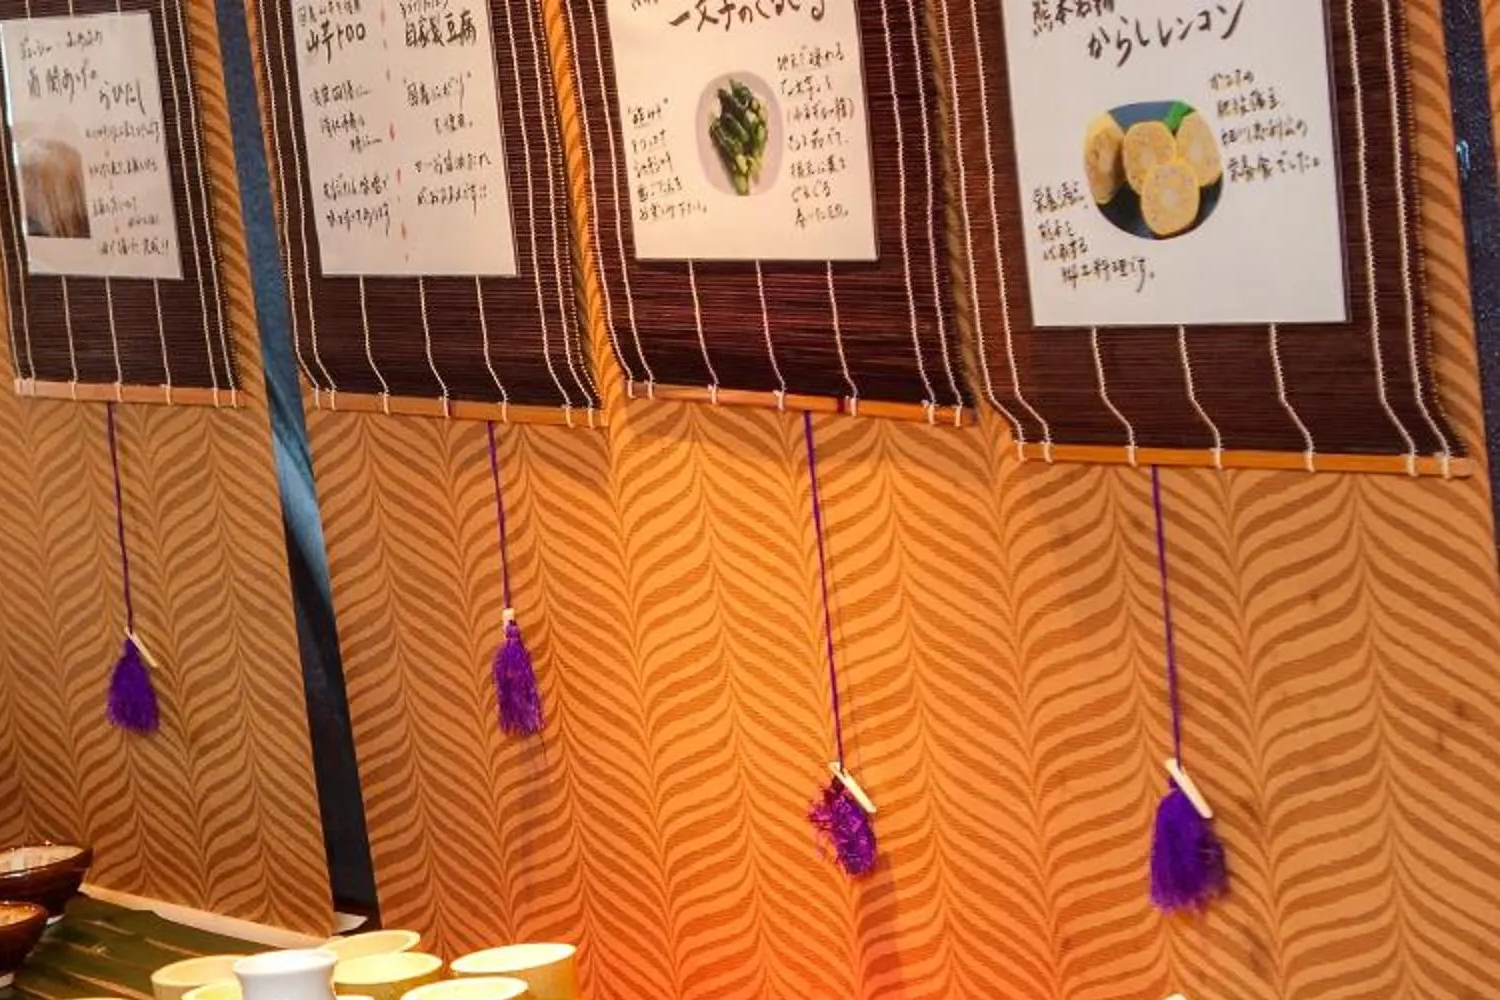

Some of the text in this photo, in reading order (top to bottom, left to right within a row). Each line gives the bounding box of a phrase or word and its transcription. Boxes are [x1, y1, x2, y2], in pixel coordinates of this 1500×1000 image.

[405, 9, 477, 48] 自家製豆腐
